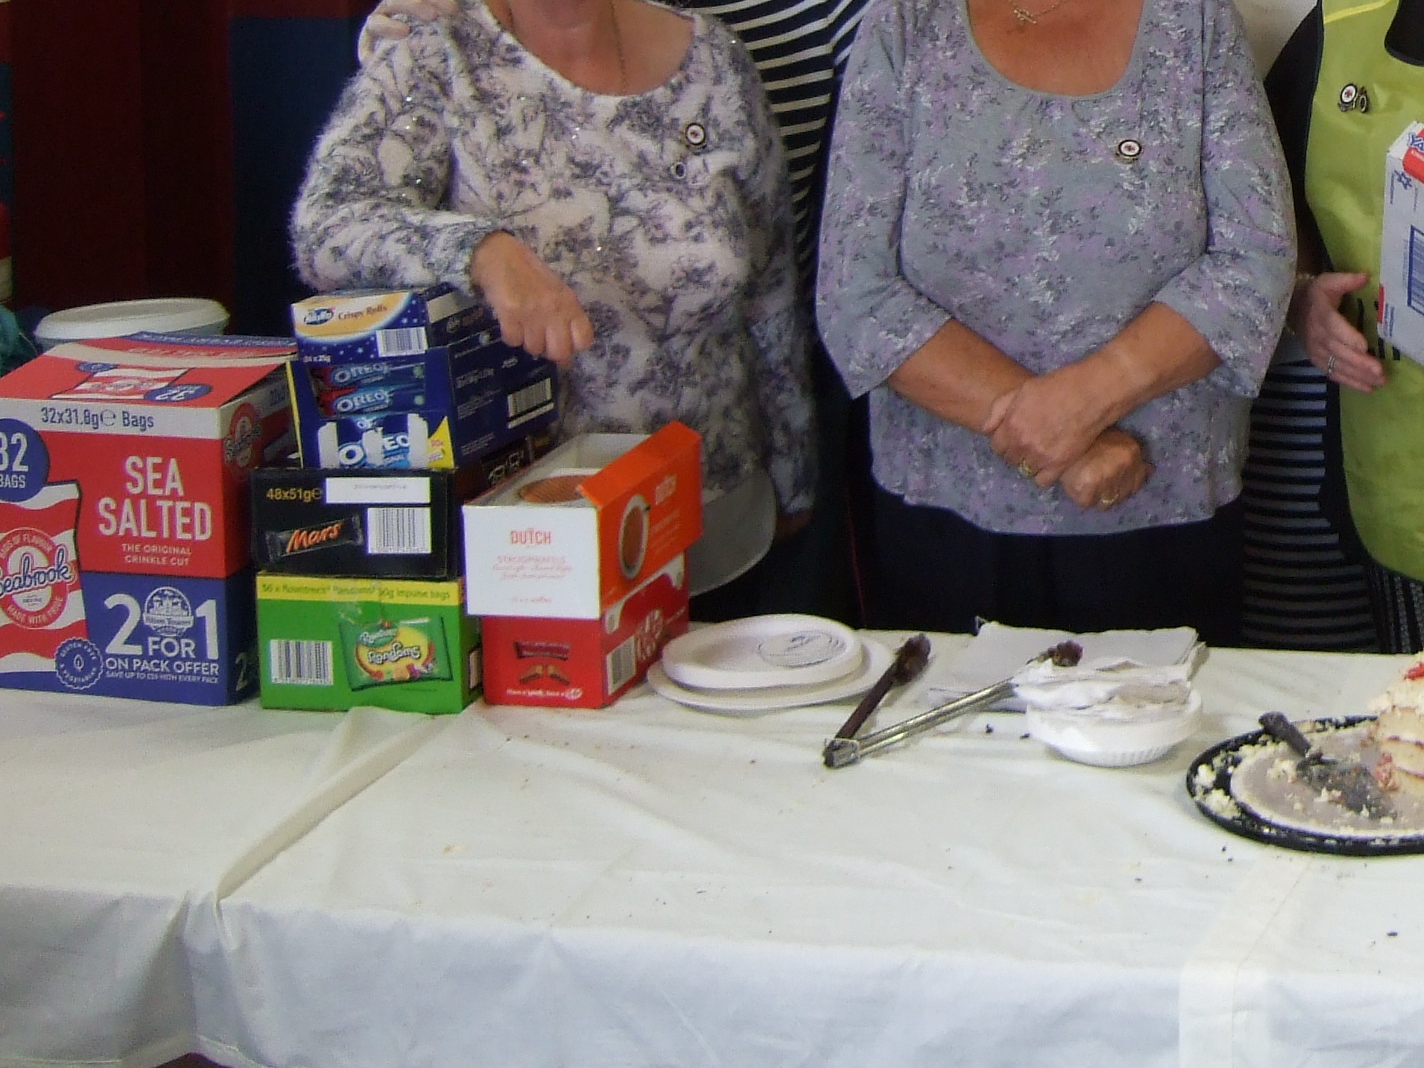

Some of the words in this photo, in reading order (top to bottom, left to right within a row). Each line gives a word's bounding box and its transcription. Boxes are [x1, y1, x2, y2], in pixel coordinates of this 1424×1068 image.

[337, 391, 387, 412] OREO
[122, 411, 155, 431] Bags
[339, 434, 410, 466] OEO
[125, 456, 184, 496] SEA
[98, 496, 212, 541] SALTED
[121, 543, 141, 553] THE
[286, 523, 343, 554] Mars
[511, 529, 551, 545] DUTCH
[104, 593, 142, 655] 2
[147, 636, 196, 658] FOR
[196, 599, 219, 660] 1
[105, 657, 129, 671] ON
[133, 658, 170, 673] PACK
[173, 661, 219, 676] OFFER
